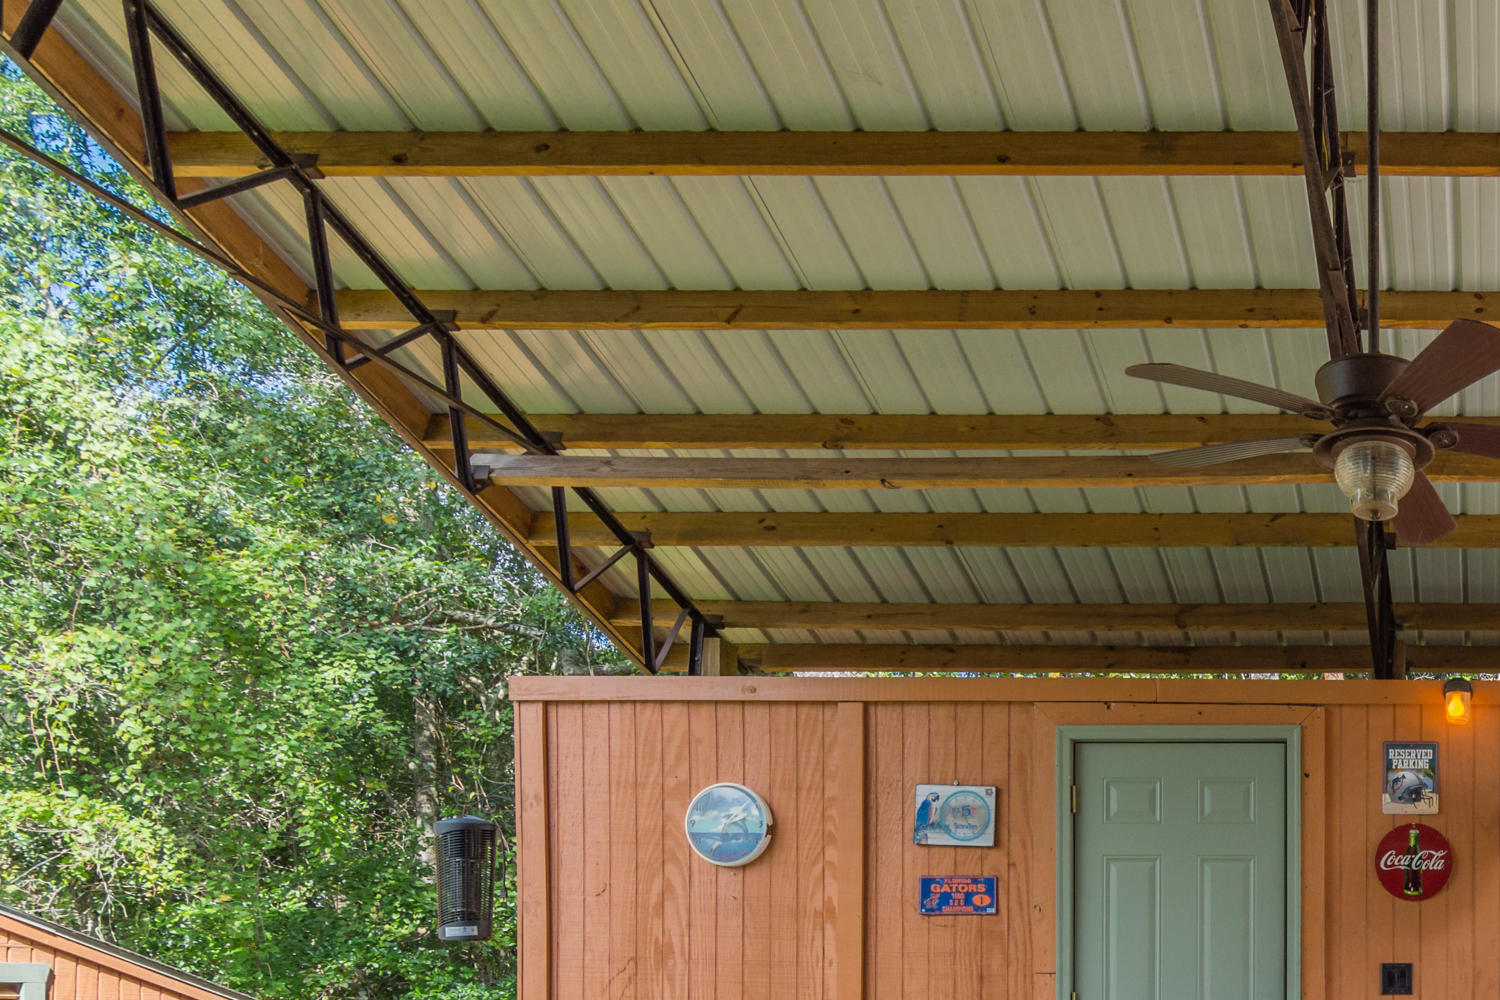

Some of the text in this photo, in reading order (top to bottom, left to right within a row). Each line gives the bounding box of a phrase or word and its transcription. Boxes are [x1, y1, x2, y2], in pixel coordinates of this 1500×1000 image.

[1388, 749, 1433, 760] RESERVED
[1392, 759, 1430, 769] PARKING
[1380, 850, 1448, 871] Coca-Cola
[930, 883, 986, 893] GATORS
